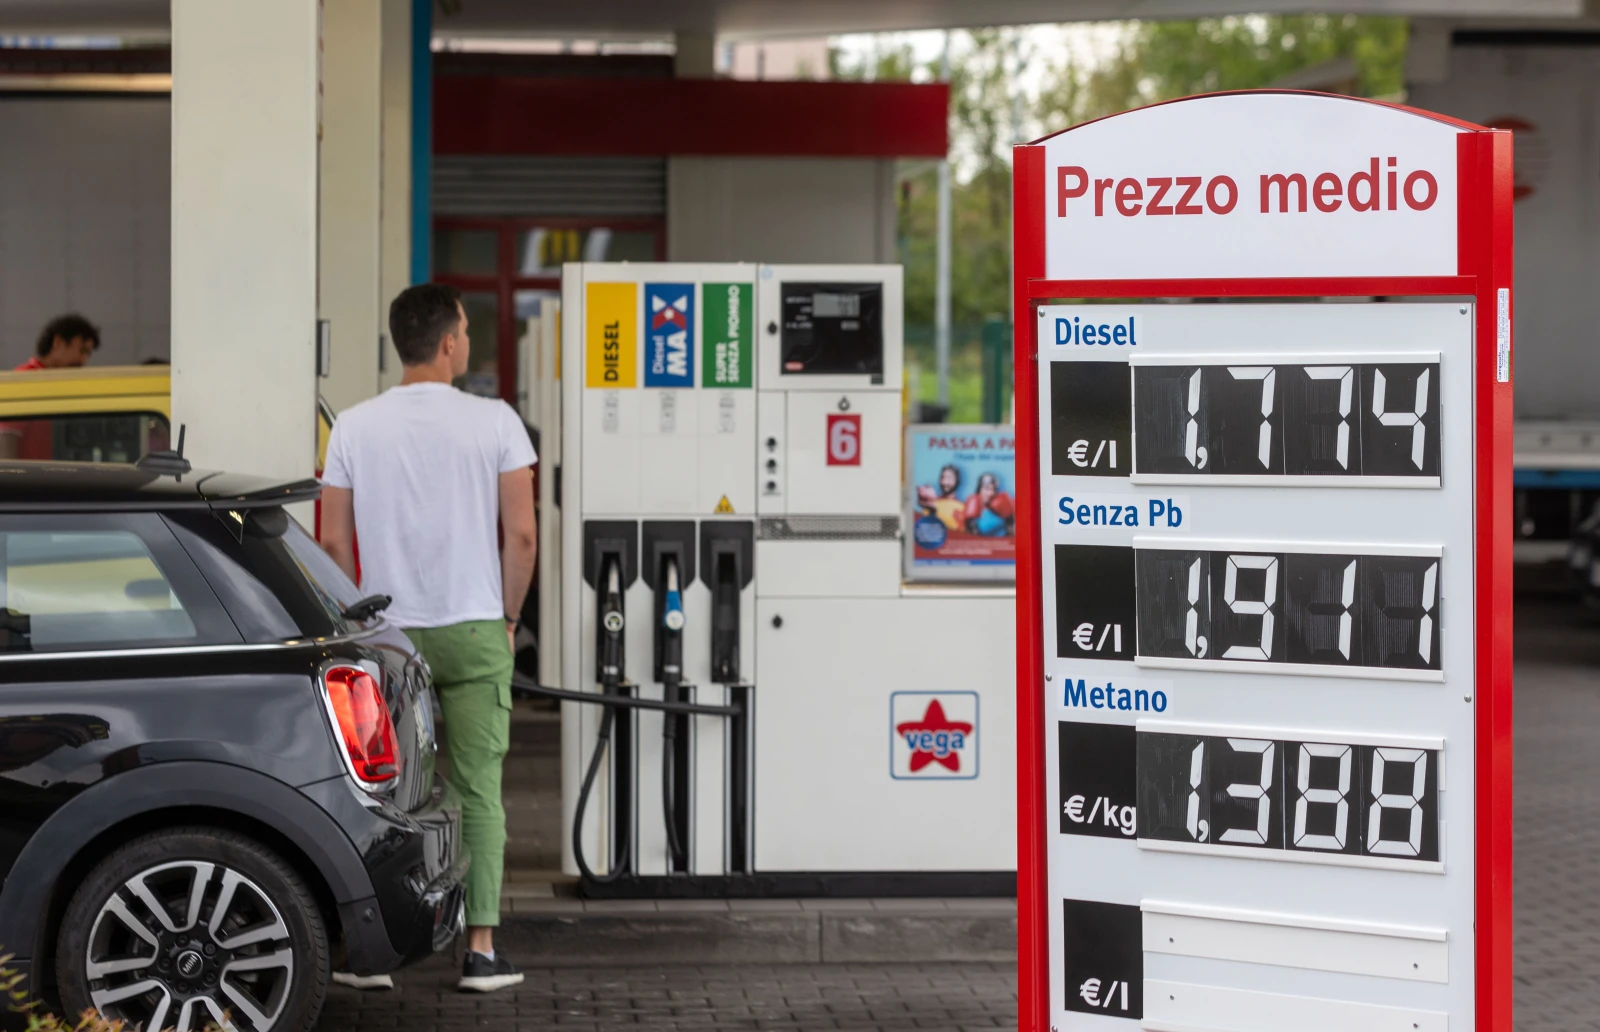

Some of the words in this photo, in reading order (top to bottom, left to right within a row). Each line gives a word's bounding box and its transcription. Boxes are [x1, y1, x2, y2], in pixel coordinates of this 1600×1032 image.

[1057, 165, 1239, 218] Prezzo
[1259, 156, 1439, 214] medio
[728, 285, 740, 338] PIOMBO
[1054, 316, 1137, 347] Diesel
[604, 320, 619, 383] DIESEL
[652, 335, 665, 374] Diesel
[715, 342, 727, 383] SUPER
[728, 340, 740, 383] SENZA
[1185, 366, 1430, 472] 1,774
[830, 420, 858, 462] 6
[928, 437, 978, 450] PASSA
[983, 438, 995, 450] A
[1057, 496, 1140, 527] Senza
[1148, 499, 1184, 528] Pb
[1184, 554, 1438, 665] 1,911
[1062, 678, 1168, 713] Metano
[905, 732, 965, 757] vega
[1063, 794, 1137, 836] €/kg
[1185, 737, 1428, 857] 1,388
[182, 954, 198, 974] MINI
